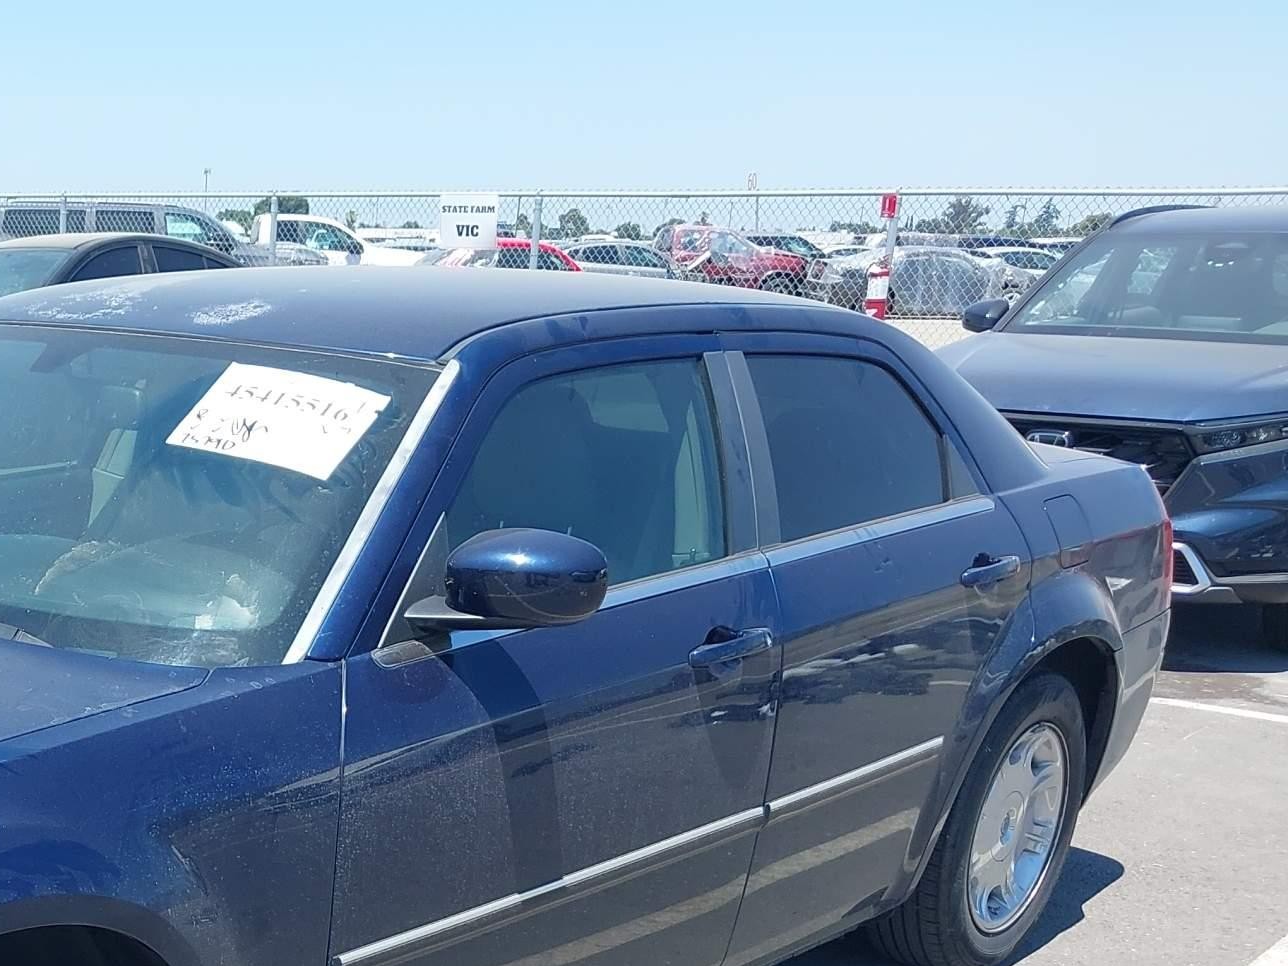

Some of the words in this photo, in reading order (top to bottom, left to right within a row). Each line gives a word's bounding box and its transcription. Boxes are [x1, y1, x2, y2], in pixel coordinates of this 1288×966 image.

[441, 205, 469, 214] STATE
[470, 205, 496, 214] FARM
[455, 224, 480, 237] VIC
